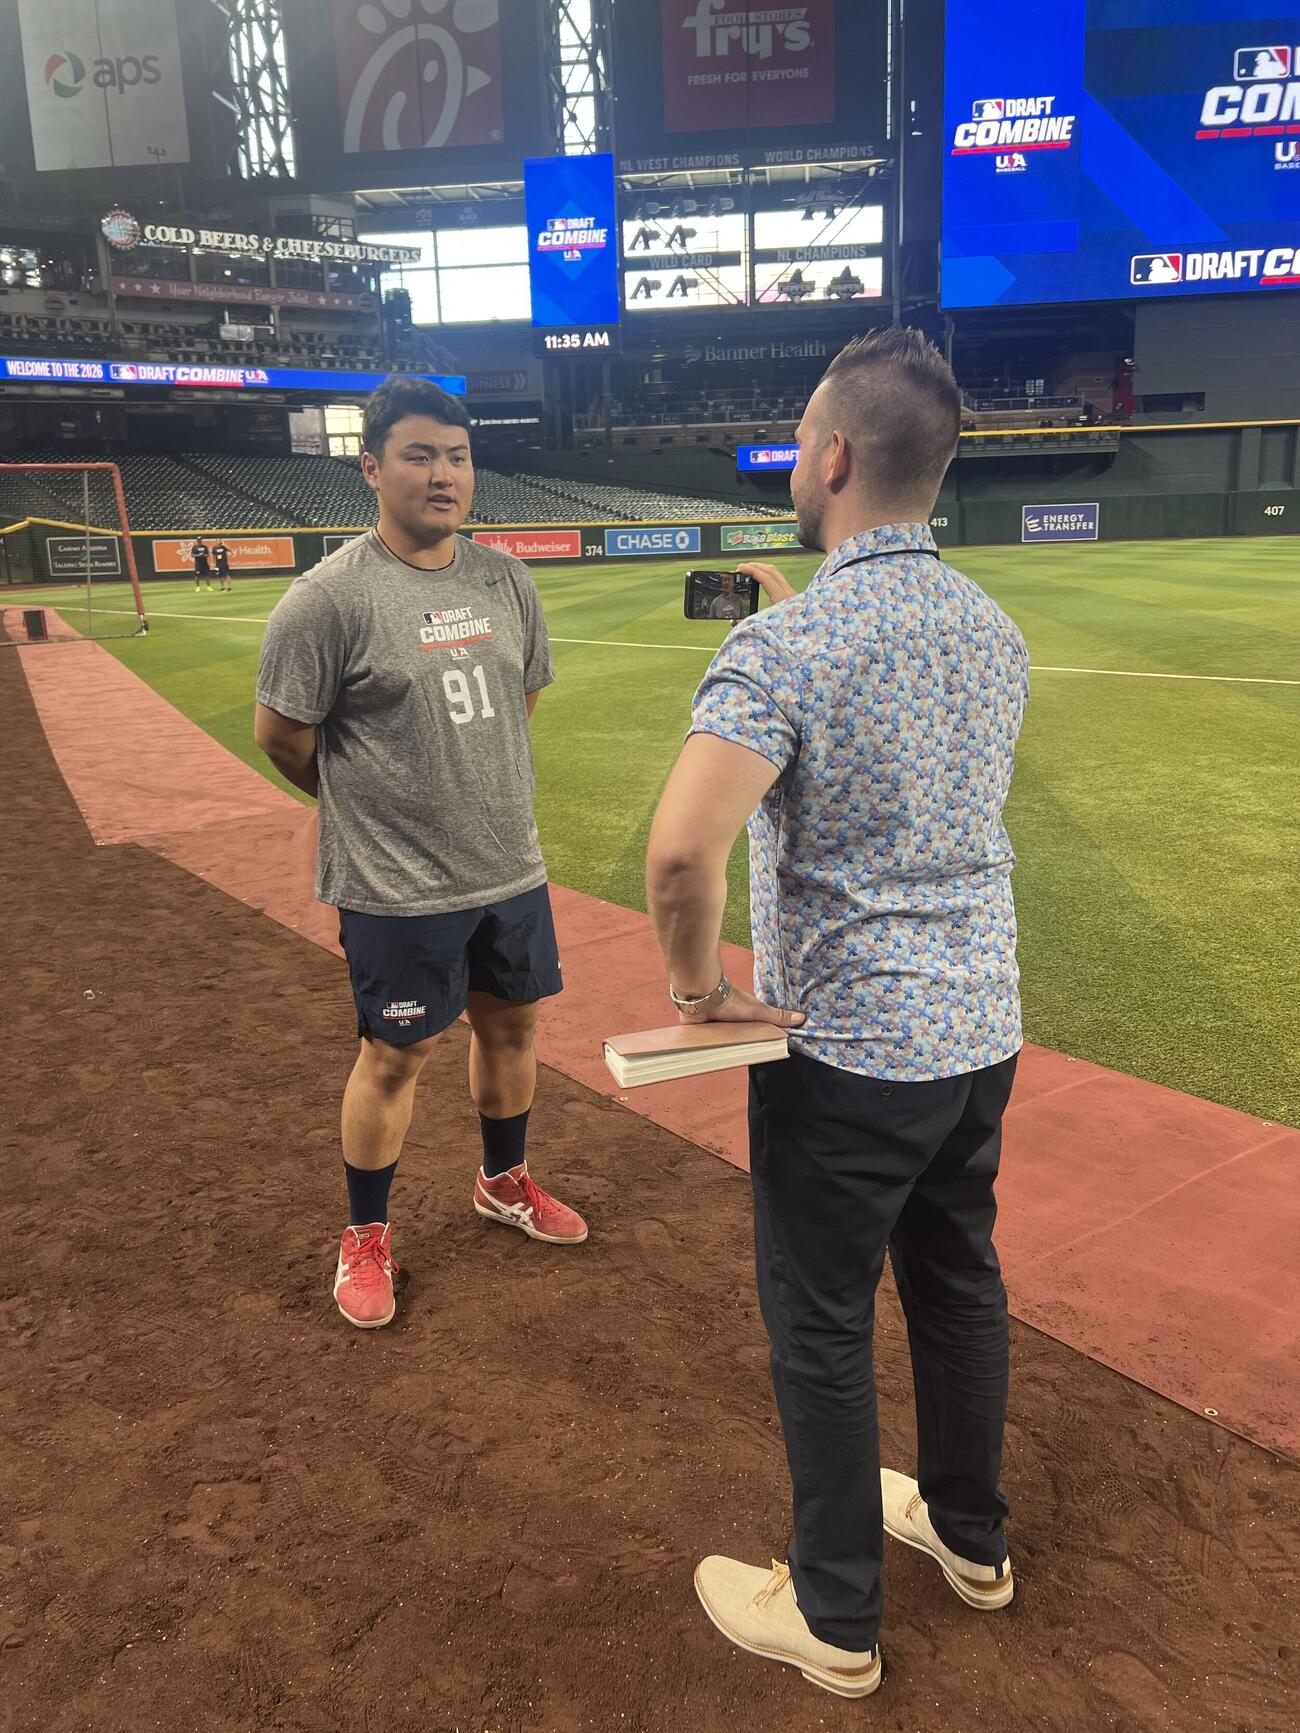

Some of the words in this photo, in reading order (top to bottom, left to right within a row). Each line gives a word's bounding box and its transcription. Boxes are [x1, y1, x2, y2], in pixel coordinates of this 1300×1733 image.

[714, 14, 746, 25] FOOD
[754, 10, 803, 22] STORES
[681, 0, 811, 59] fry's
[93, 53, 162, 94] aps
[687, 74, 721, 86] FRESH
[725, 72, 748, 83] FOR
[752, 67, 808, 81] EVERYONE
[1005, 96, 1055, 117] DRAFT
[954, 115, 1075, 147] COMBINE
[764, 150, 803, 162] WORLD
[806, 145, 874, 160] CHAMPIONS
[637, 158, 669, 170] WEST
[672, 154, 740, 168] CHAMPIONS
[567, 217, 596, 229] DRAFT
[144, 225, 195, 244] COLD
[199, 230, 259, 250] BEERS
[263, 237, 274, 251] &
[276, 238, 421, 263] CHEESEBURGERS
[538, 229, 608, 246] COMBINE
[649, 257, 678, 268] WILD
[681, 254, 713, 266] CARD
[777, 250, 791, 261] NL
[796, 245, 866, 260] CHAMPIONS
[1185, 250, 1265, 280] DRAFT
[169, 283, 191, 297] Your
[194, 285, 253, 300] Neighborhood
[544, 333, 580, 349] 11:35
[583, 331, 609, 347] AM
[705, 345, 767, 361] Banner
[770, 339, 826, 358] Health
[7, 360, 50, 377] WELCOME
[51, 363, 62, 377] TO
[63, 363, 81, 377] THE
[81, 364, 103, 378] 2026
[139, 366, 176, 381] DRAFT
[176, 368, 244, 383] COMBINE
[771, 449, 800, 462] DRAFT
[1043, 514, 1085, 523] ENERGY
[1264, 505, 1285, 517] 407
[930, 518, 948, 527] 413
[1043, 522, 1094, 531] TRANSFER
[617, 533, 673, 549] CHASE
[743, 533, 767, 544] Baja
[766, 531, 795, 543] Blast
[239, 545, 272, 555] Health
[516, 541, 571, 553] Budweiser
[585, 545, 603, 556] 374
[441, 607, 473, 623] DRAFT
[420, 618, 492, 643] COMBINE
[442, 665, 495, 724] 91
[383, 1006, 426, 1017] COMBINE
[399, 1000, 418, 1009] DRAFT
